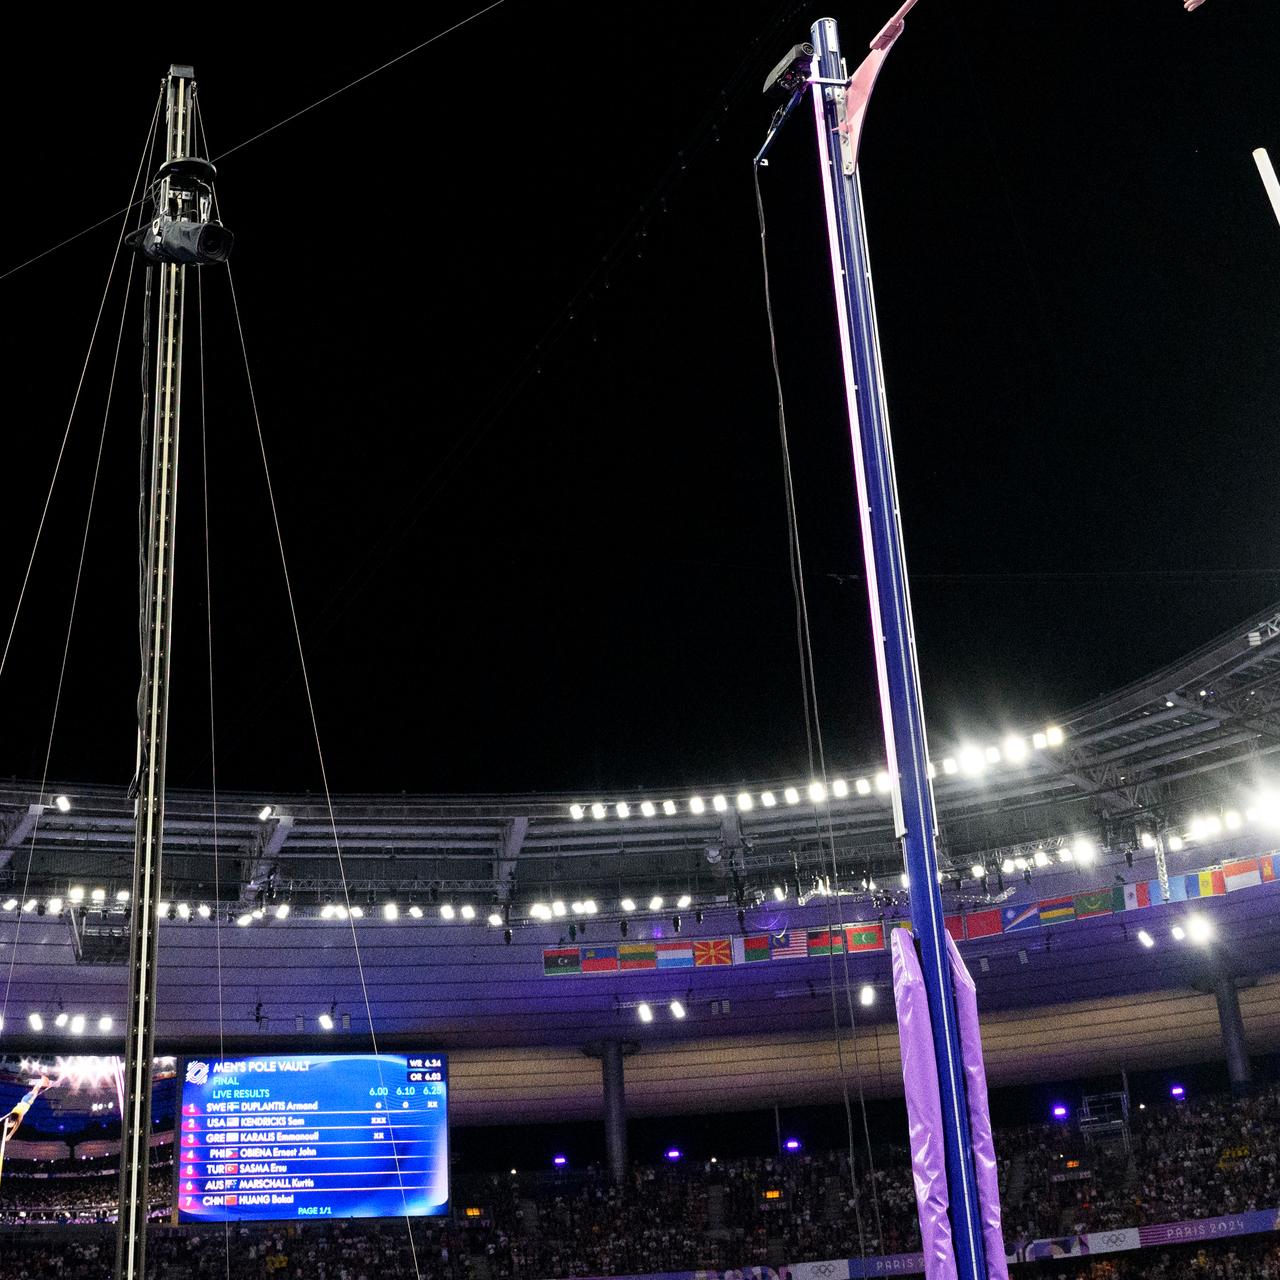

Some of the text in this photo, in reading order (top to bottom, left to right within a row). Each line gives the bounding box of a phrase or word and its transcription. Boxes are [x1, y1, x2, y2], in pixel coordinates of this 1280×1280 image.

[213, 1061, 311, 1073] MEN'S POLE VAULT
[409, 1059, 442, 1067] WR 6.24
[213, 1076, 240, 1085] FINAL
[410, 1072, 442, 1081] OR 6.03
[213, 1089, 270, 1099] LIVE RESULTS
[369, 1086, 442, 1096] 6.00 6.10 6.25
[206, 1102, 227, 1113] SWE
[241, 1101, 286, 1112] DUPLANTIS
[286, 1100, 319, 1111] Armand
[207, 1118, 226, 1128] USA
[240, 1116, 287, 1127] KENDRICKS
[287, 1116, 305, 1126] Sam
[205, 1133, 225, 1143] GRE
[240, 1133, 275, 1143] KARALIS
[209, 1149, 225, 1159] PHI
[240, 1148, 272, 1158] OBIENA
[273, 1147, 298, 1157] Ernest
[298, 1146, 317, 1157] John
[206, 1165, 225, 1174] TUR
[239, 1164, 270, 1174] SASMA
[205, 1180, 225, 1190] AUS
[239, 1179, 291, 1189] MARSCHALL
[291, 1178, 315, 1188] Kurtis
[202, 1196, 224, 1206] CHN
[239, 1195, 271, 1205] HUANG
[298, 1206, 333, 1215] PAGE 1/1
[1166, 1218, 1246, 1240] PARIS 2024
[876, 1258, 914, 1271] PARIS
